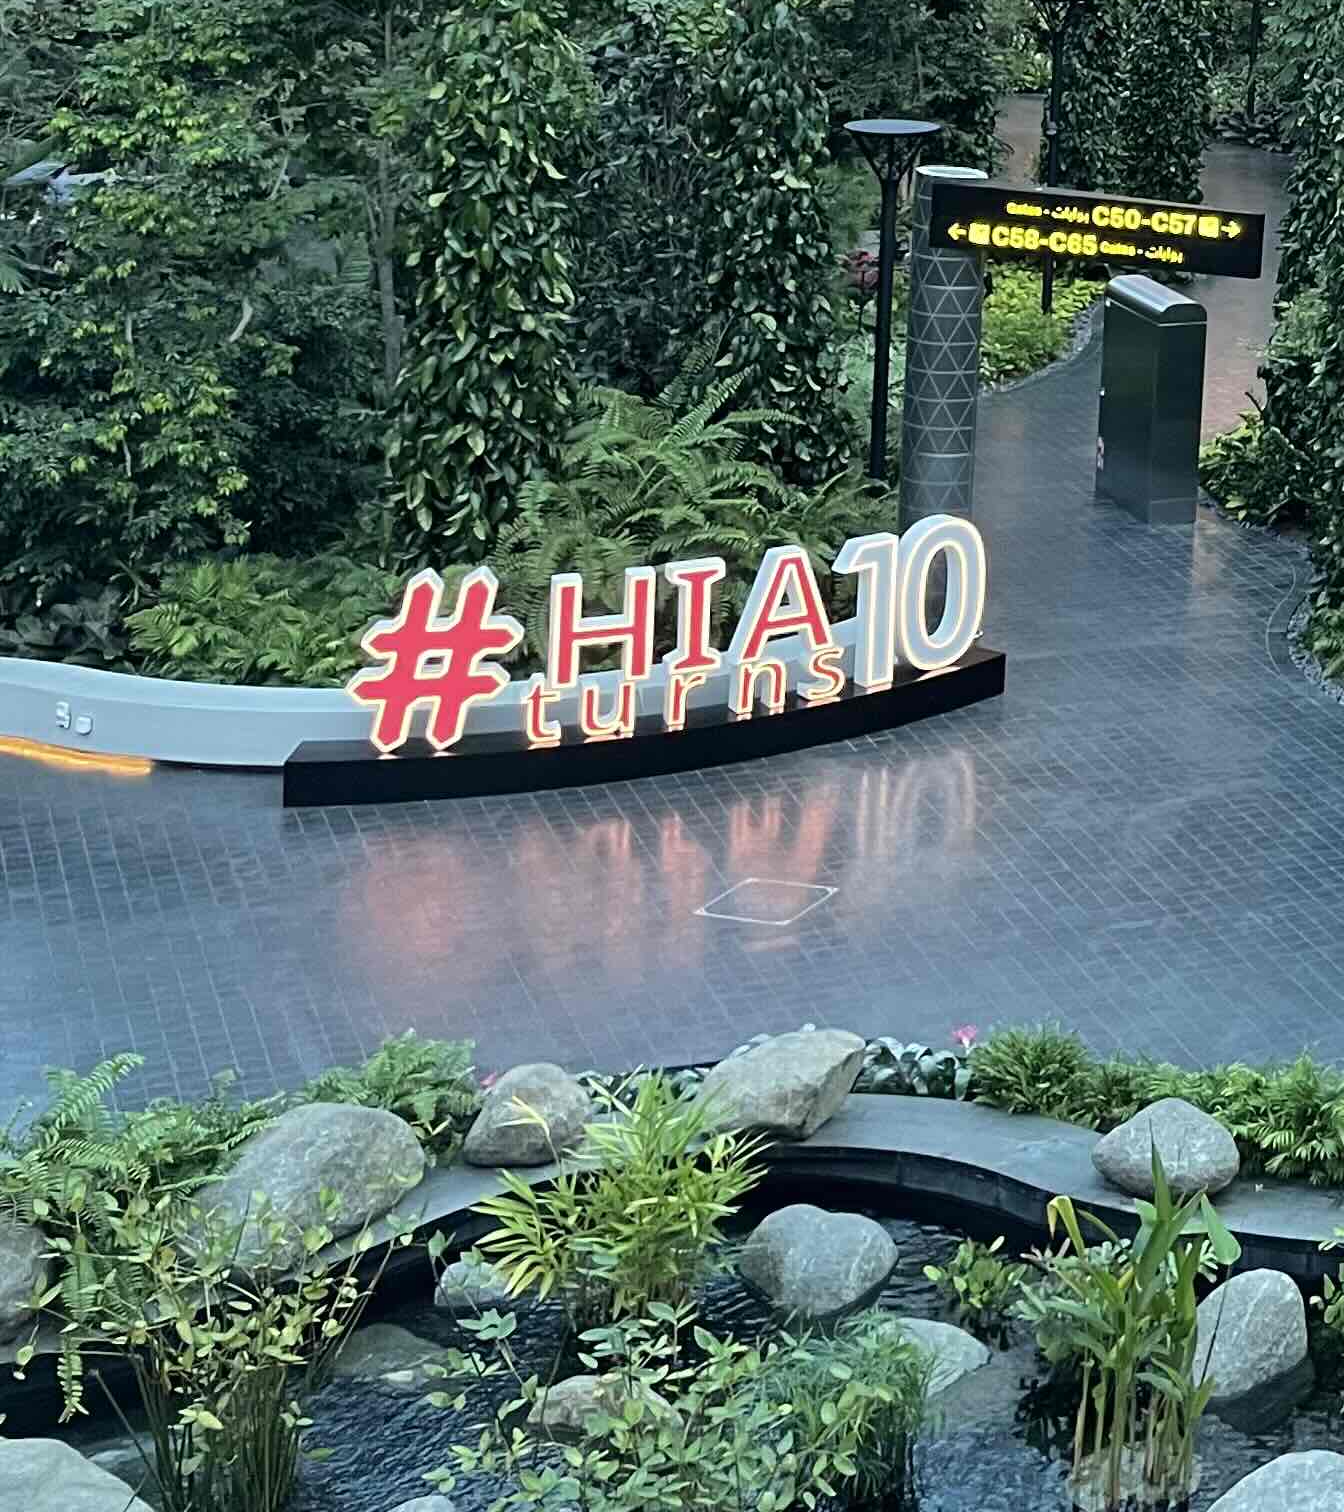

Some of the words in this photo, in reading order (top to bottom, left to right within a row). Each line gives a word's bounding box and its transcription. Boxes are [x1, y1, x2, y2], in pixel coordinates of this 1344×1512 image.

[991, 225, 1098, 256] C58-C65
[1091, 205, 1198, 235] C50-C57
[832, 513, 987, 688] 10
[524, 644, 844, 744] turns
